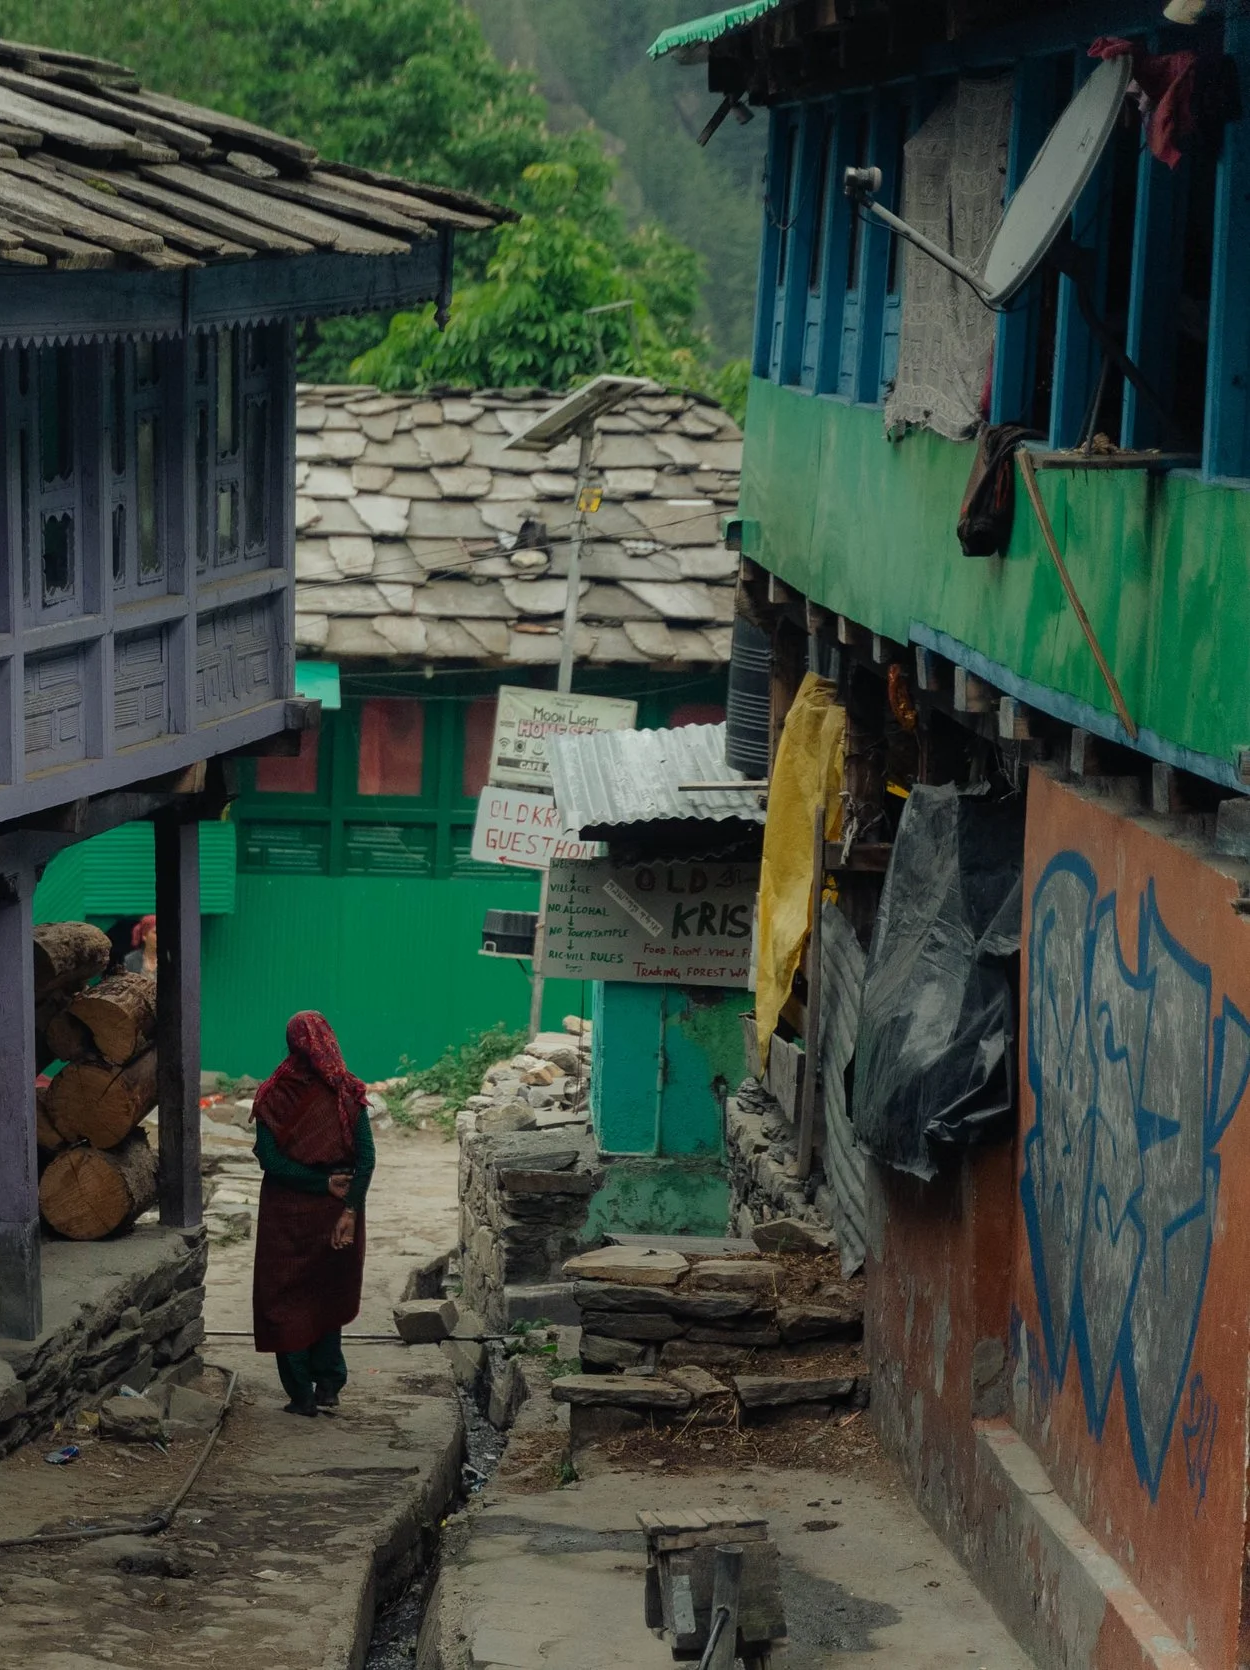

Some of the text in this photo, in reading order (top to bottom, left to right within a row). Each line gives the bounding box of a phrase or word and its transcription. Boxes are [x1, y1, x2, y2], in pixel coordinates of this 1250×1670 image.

[533, 706, 599, 728] MOON LIGHT
[519, 761, 544, 772] CAFE
[634, 866, 708, 895] OLD
[550, 884, 592, 895] VILLAGE
[671, 901, 751, 940] KRIS
[590, 951, 624, 964] RULES
[686, 967, 727, 977] FOREST
